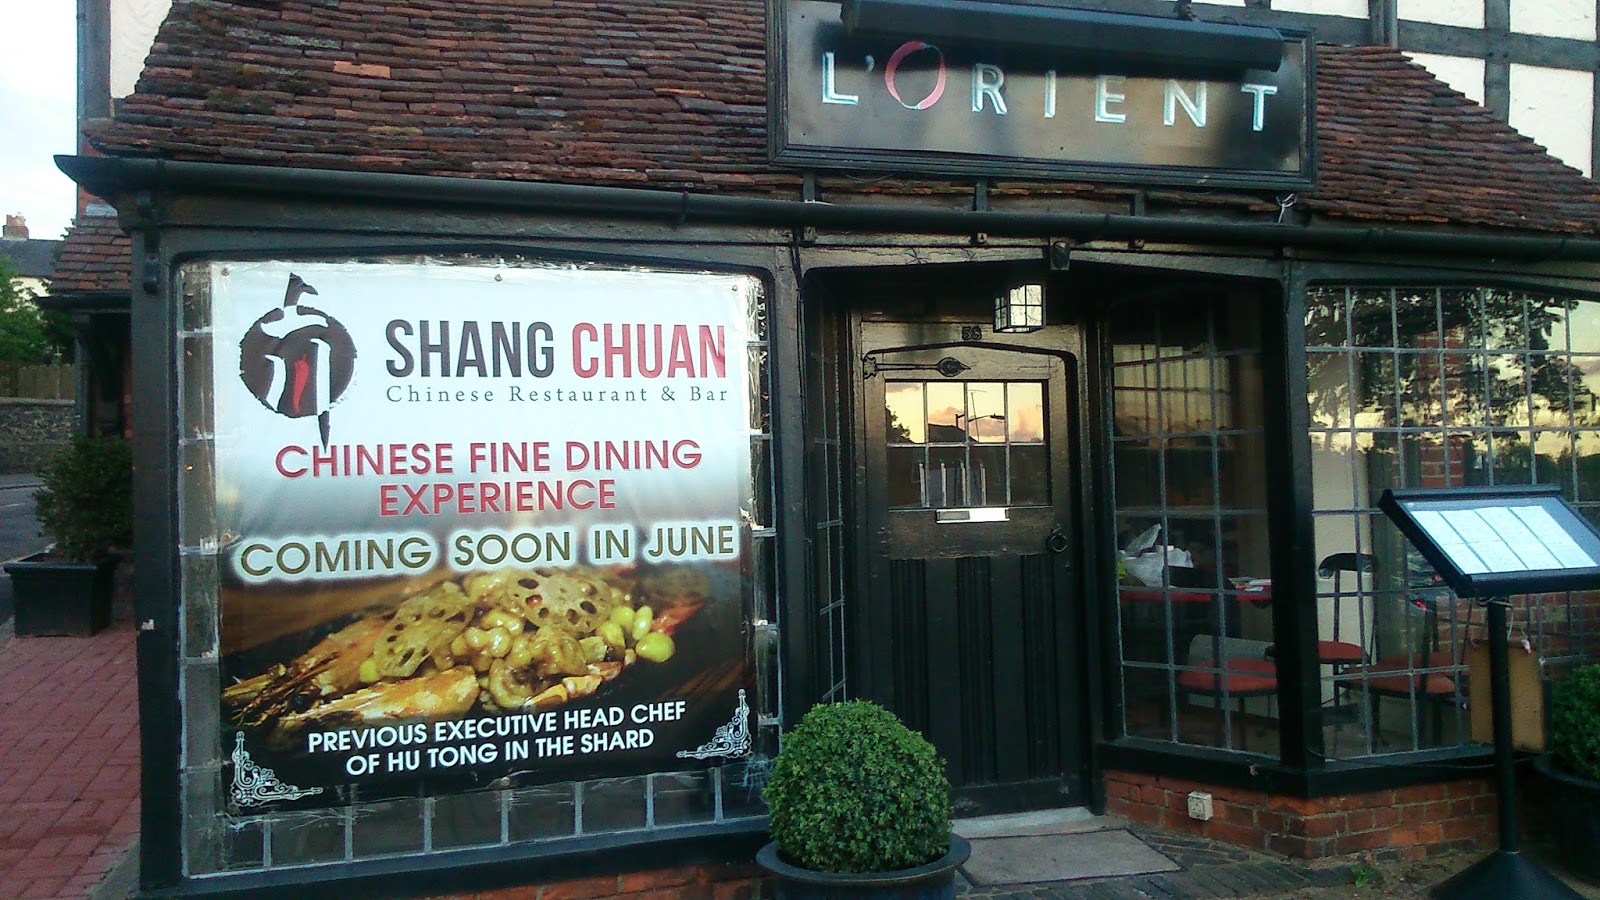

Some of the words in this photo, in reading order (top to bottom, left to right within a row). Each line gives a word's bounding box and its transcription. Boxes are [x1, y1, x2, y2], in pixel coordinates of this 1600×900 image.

[821, 40, 1278, 131] L'ORIENT
[385, 319, 555, 378] SHANG
[572, 322, 726, 378] CHUAN
[386, 385, 494, 402] Chinese
[509, 386, 647, 402] Restaurant
[661, 386, 676, 401] &
[690, 386, 727, 401] Bar
[275, 443, 453, 478] CHINESE
[470, 441, 550, 473] FINE
[565, 439, 702, 471] DINING
[380, 479, 616, 517] EXPERIENCE
[240, 537, 432, 576] COMING
[454, 531, 570, 566] SOON
[594, 529, 630, 559] IN
[648, 525, 734, 557] JUNE
[308, 723, 428, 753] PREVIOUS
[435, 712, 557, 742] EXECUTIVE
[564, 707, 625, 730] HEAD
[630, 701, 686, 724] CHEF
[346, 754, 380, 776] OF
[388, 750, 421, 772] HU
[427, 742, 499, 768] TONG
[505, 740, 529, 761] IN
[535, 736, 574, 758] THE
[580, 729, 654, 754] SHARD
